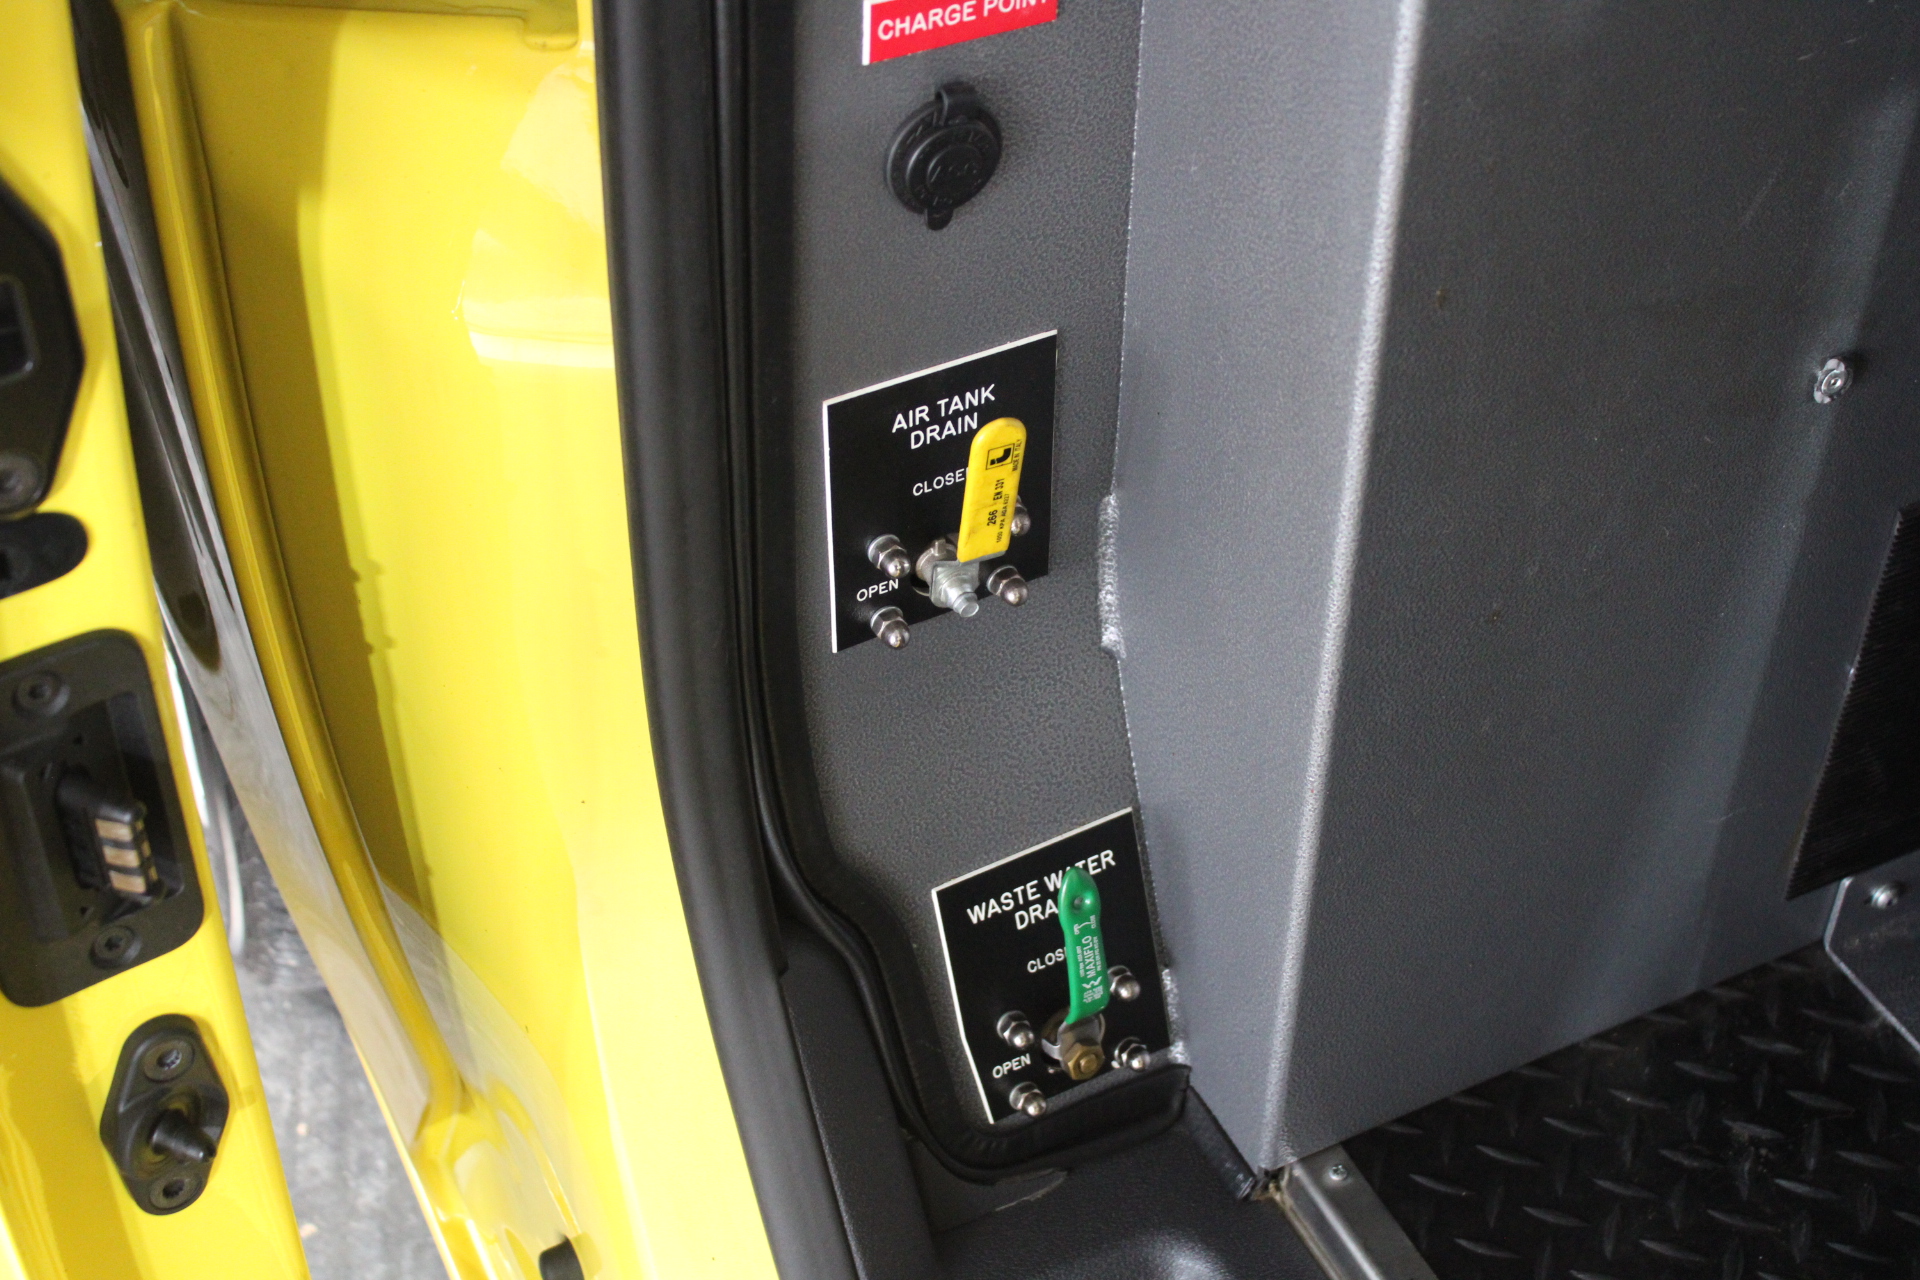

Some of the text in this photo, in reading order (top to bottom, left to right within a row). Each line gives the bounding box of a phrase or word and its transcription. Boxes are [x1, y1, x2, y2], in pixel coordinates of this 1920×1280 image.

[878, 0, 1047, 41] CHARGE POI
[892, 383, 996, 433] AIR TANK
[910, 412, 978, 449] DRAIN
[987, 509, 998, 526] 266
[993, 490, 1003, 501] EN
[856, 579, 899, 602] OPEN
[967, 849, 1116, 924] WASTE WTER
[1014, 899, 1058, 930] DRA
[1082, 935, 1096, 978] MAXIFLO
[992, 1053, 1031, 1078] OPEN
